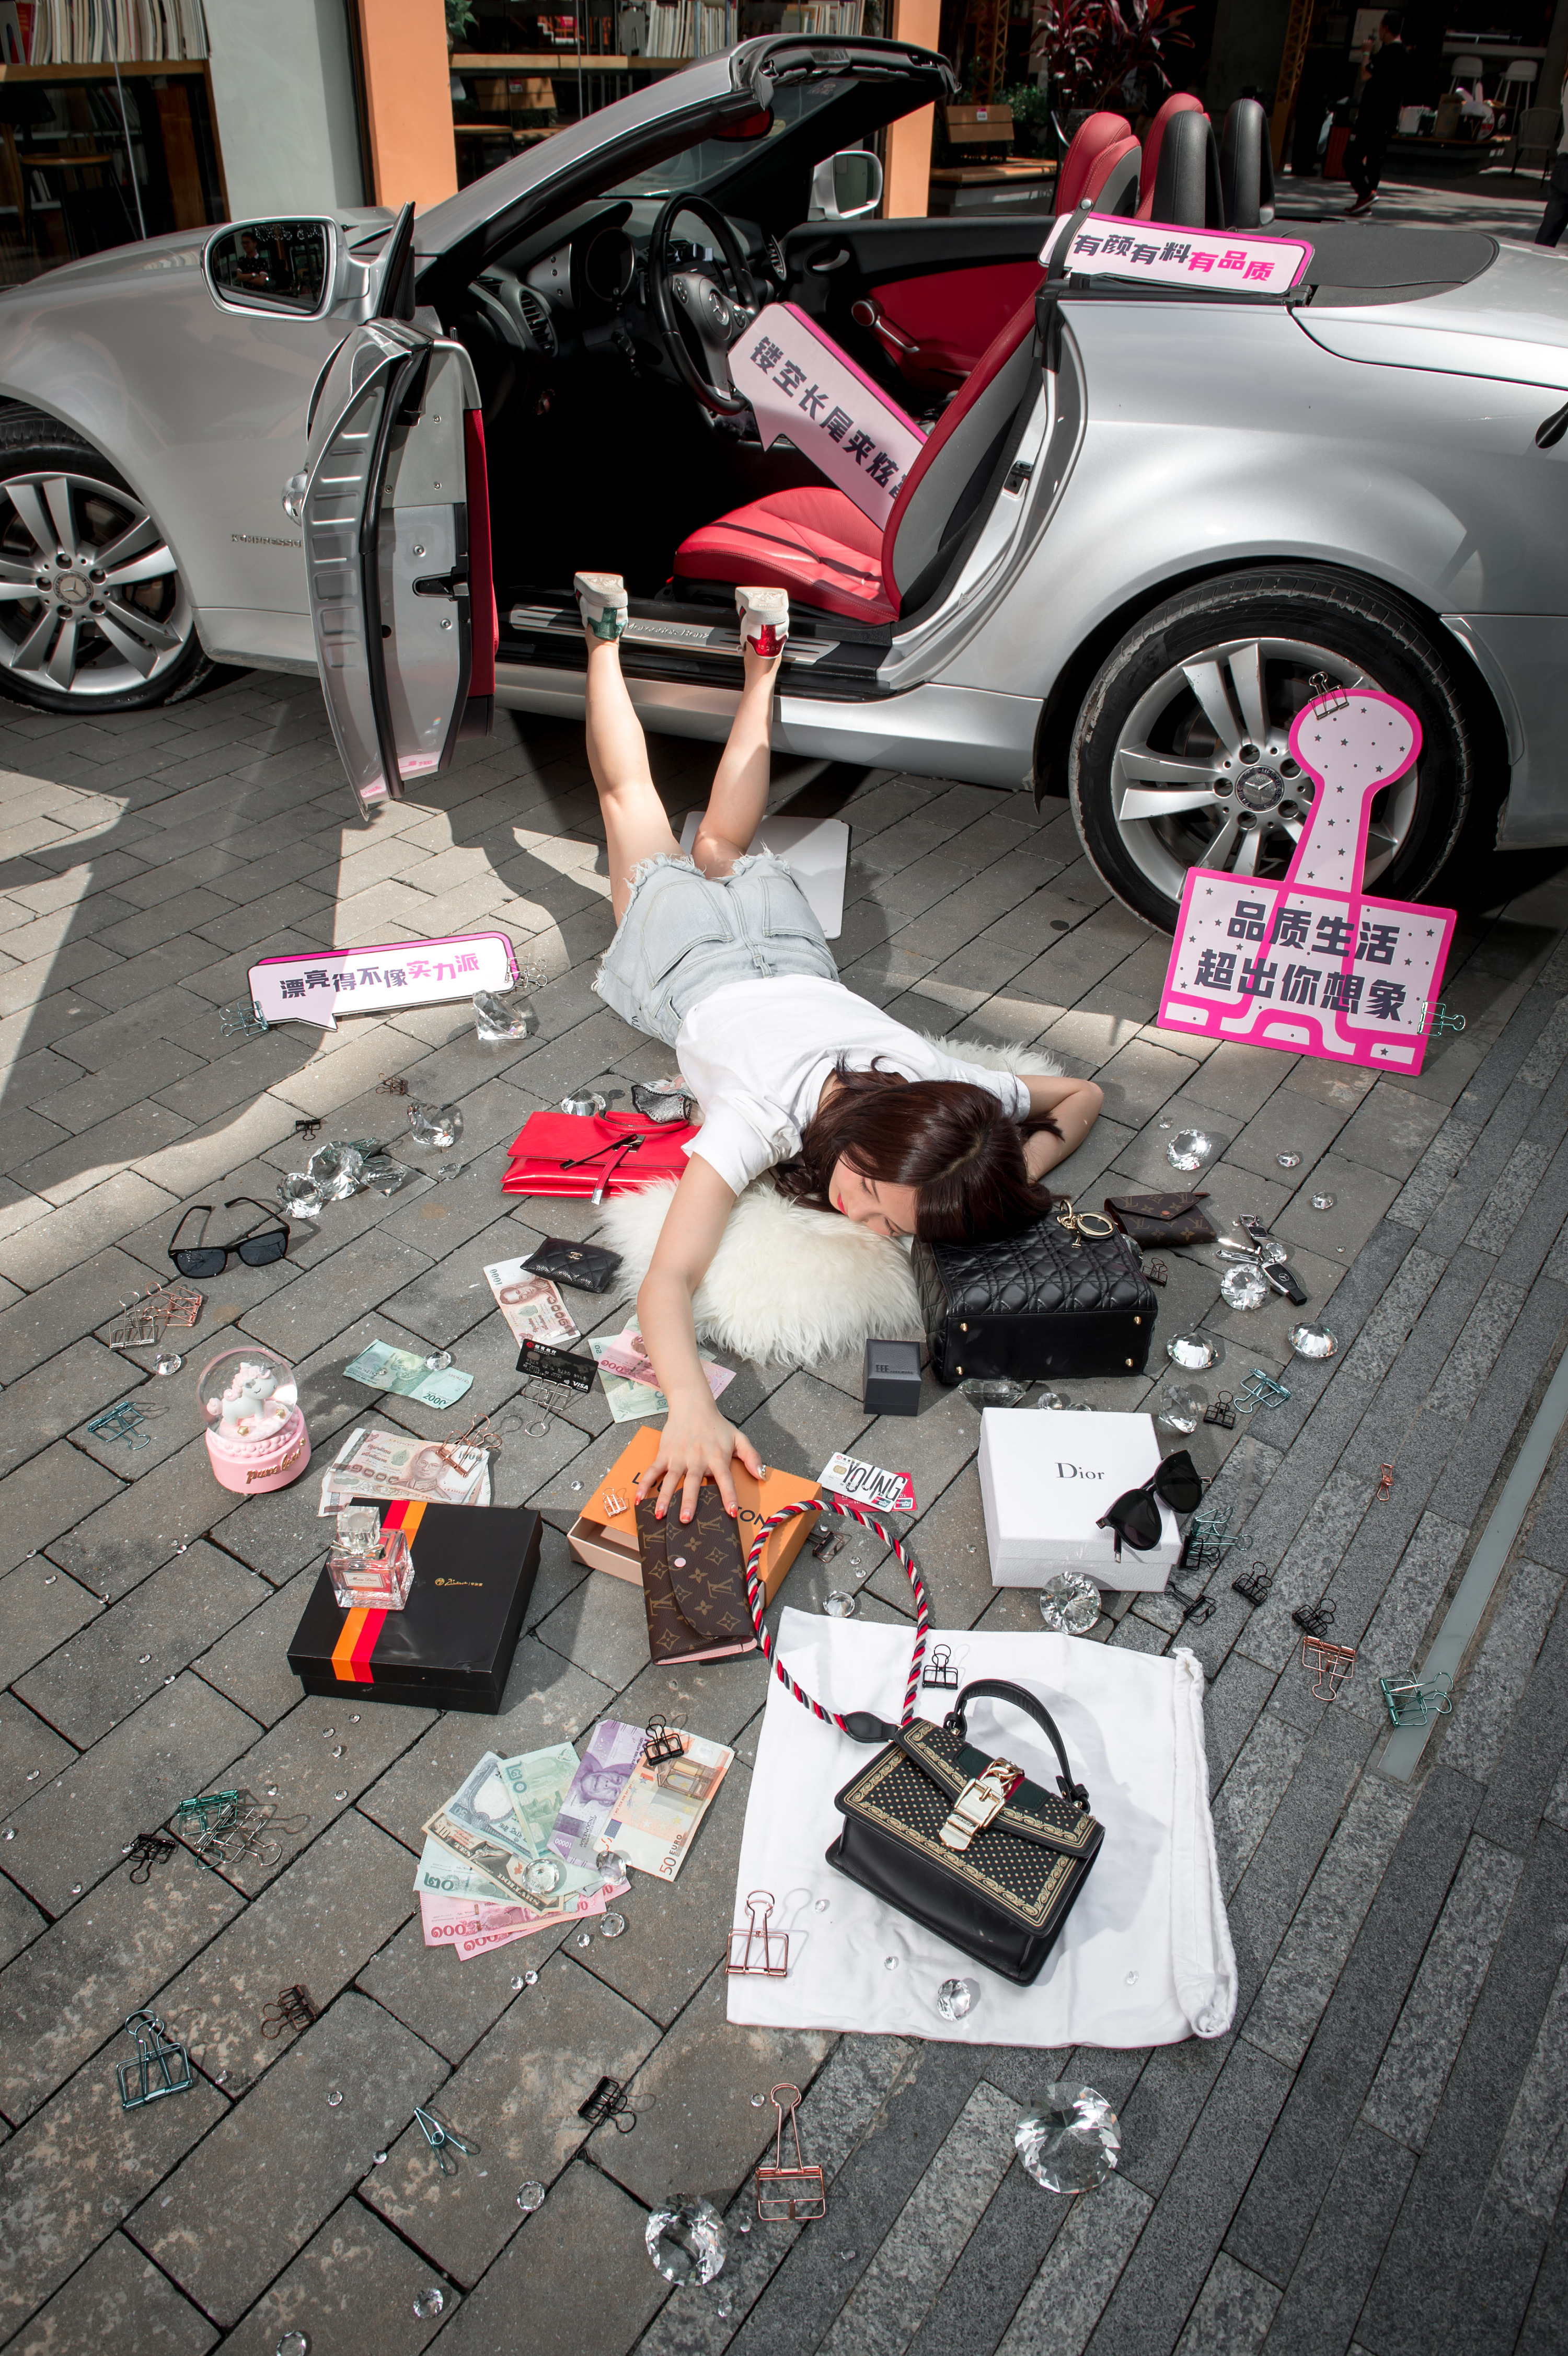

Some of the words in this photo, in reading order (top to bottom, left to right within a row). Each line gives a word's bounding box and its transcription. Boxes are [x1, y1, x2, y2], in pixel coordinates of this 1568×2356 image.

[1074, 234, 1275, 282] 有颜有料有品质
[232, 534, 302, 547] KOMPRESSO
[1261, 768, 1282, 795] MERCEDES
[1238, 790, 1250, 807] BENZ
[1227, 900, 1401, 965] 品质生活
[280, 952, 480, 999] 漂亮得不像实力派
[1193, 949, 1407, 1020] 超出你想象
[571, 1381, 589, 1390] VISA
[246, 1467, 279, 1484] pure
[843, 1466, 906, 1500] YOUNG
[1055, 1462, 1105, 1481] Dior
[555, 1838, 572, 1848] 10000
[580, 1815, 594, 1847] INDONESIA
[659, 1857, 676, 1875] 50
[669, 1834, 682, 1855] EURO
[424, 1871, 454, 1891] ๒๐
[497, 1872, 540, 1908] DOLLARS
